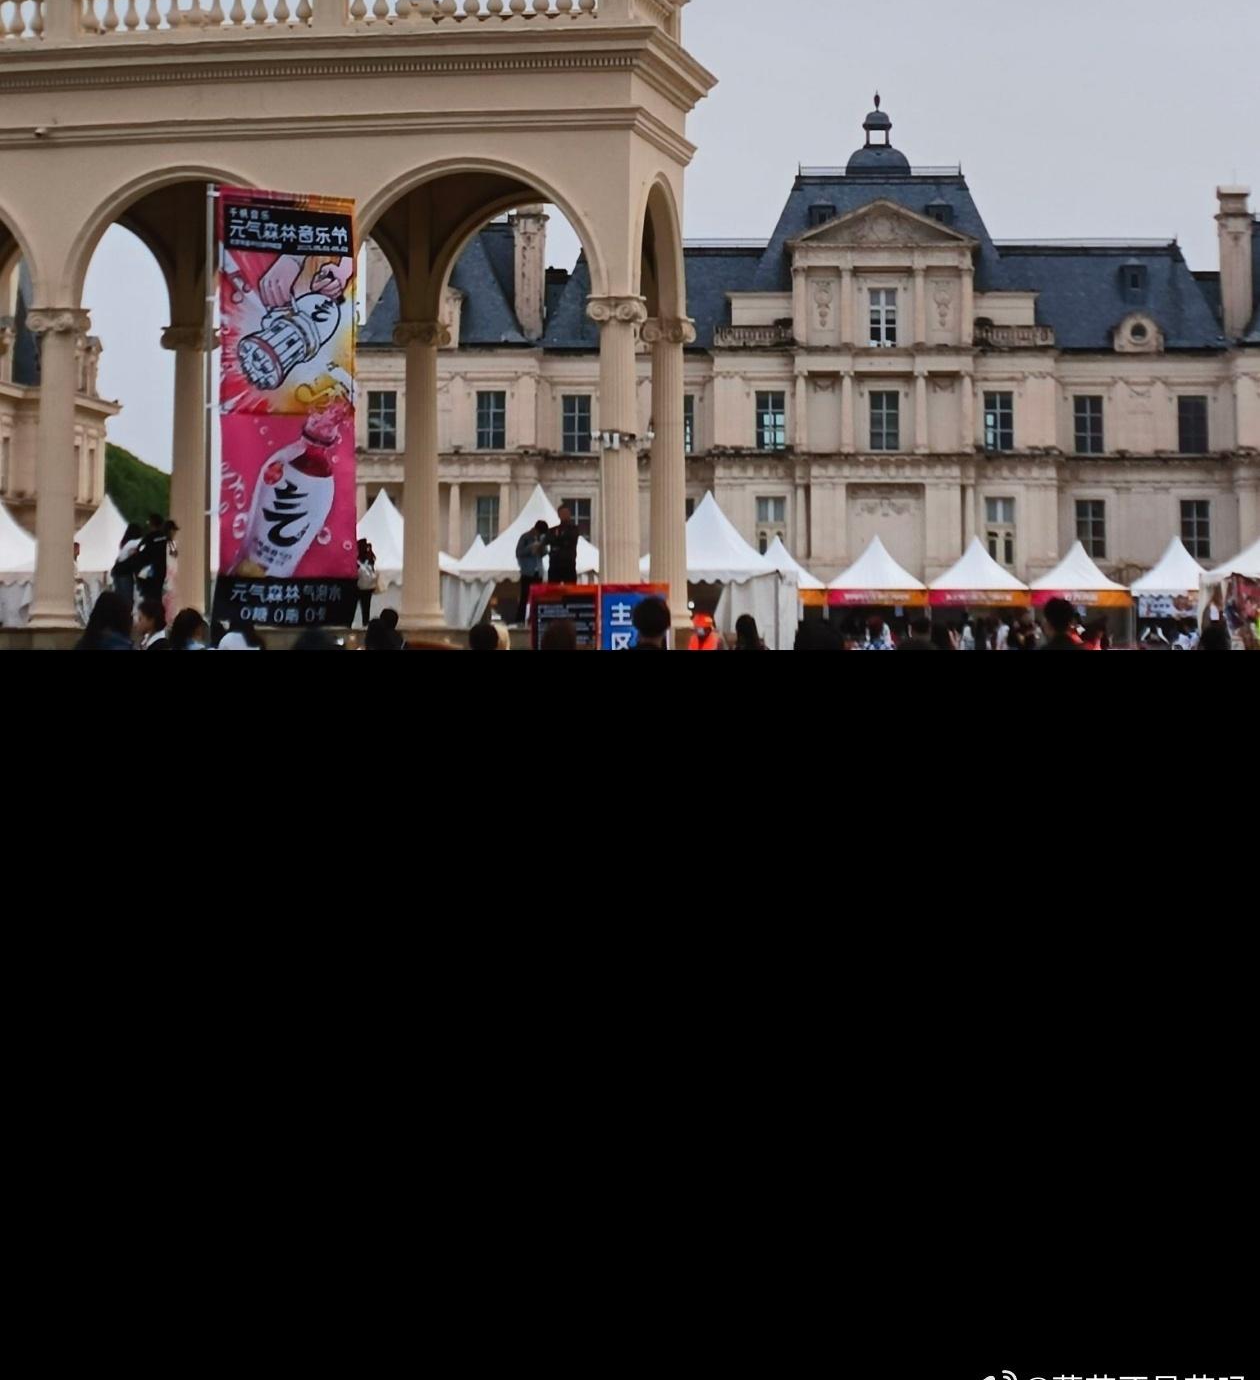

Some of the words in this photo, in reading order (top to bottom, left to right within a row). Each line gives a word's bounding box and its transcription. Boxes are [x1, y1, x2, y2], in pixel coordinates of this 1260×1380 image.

[229, 219, 348, 244] 元气森林音乐节
